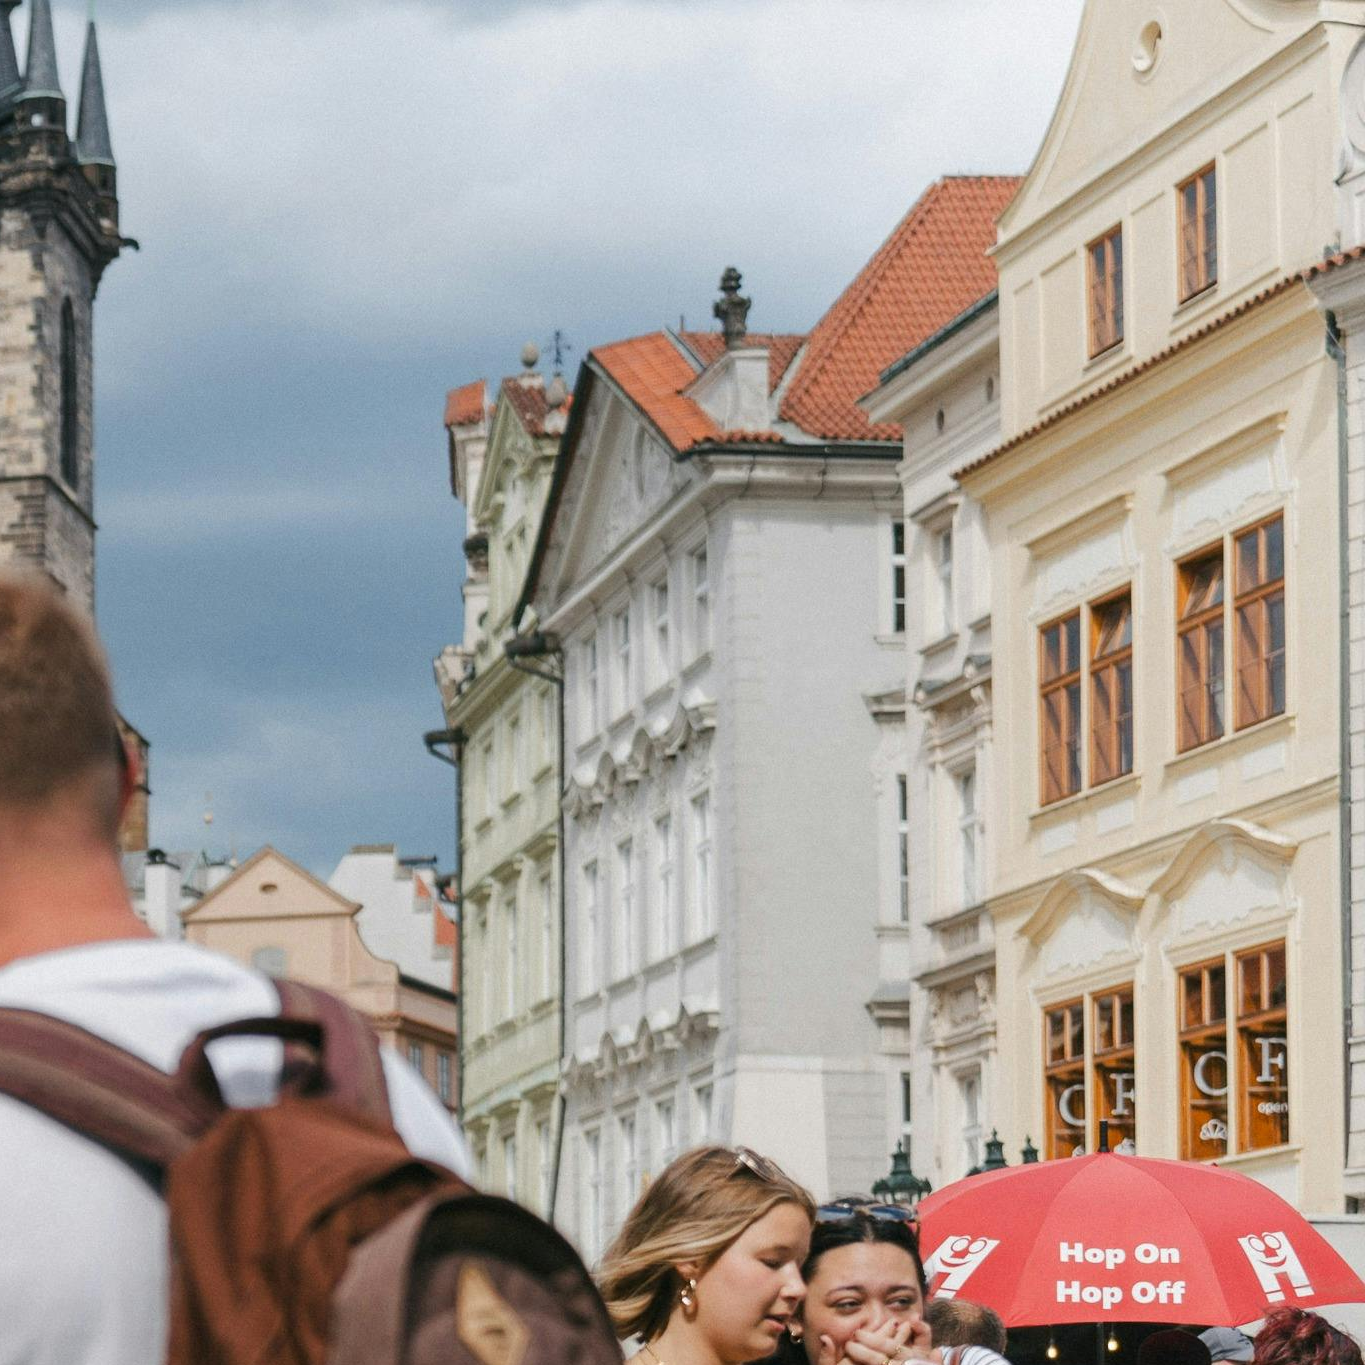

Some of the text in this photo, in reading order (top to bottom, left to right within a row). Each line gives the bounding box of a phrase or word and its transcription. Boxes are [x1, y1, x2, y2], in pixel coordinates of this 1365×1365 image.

[1059, 1241, 1180, 1270] Hop On
[1056, 1280, 1186, 1310] Hop Off
